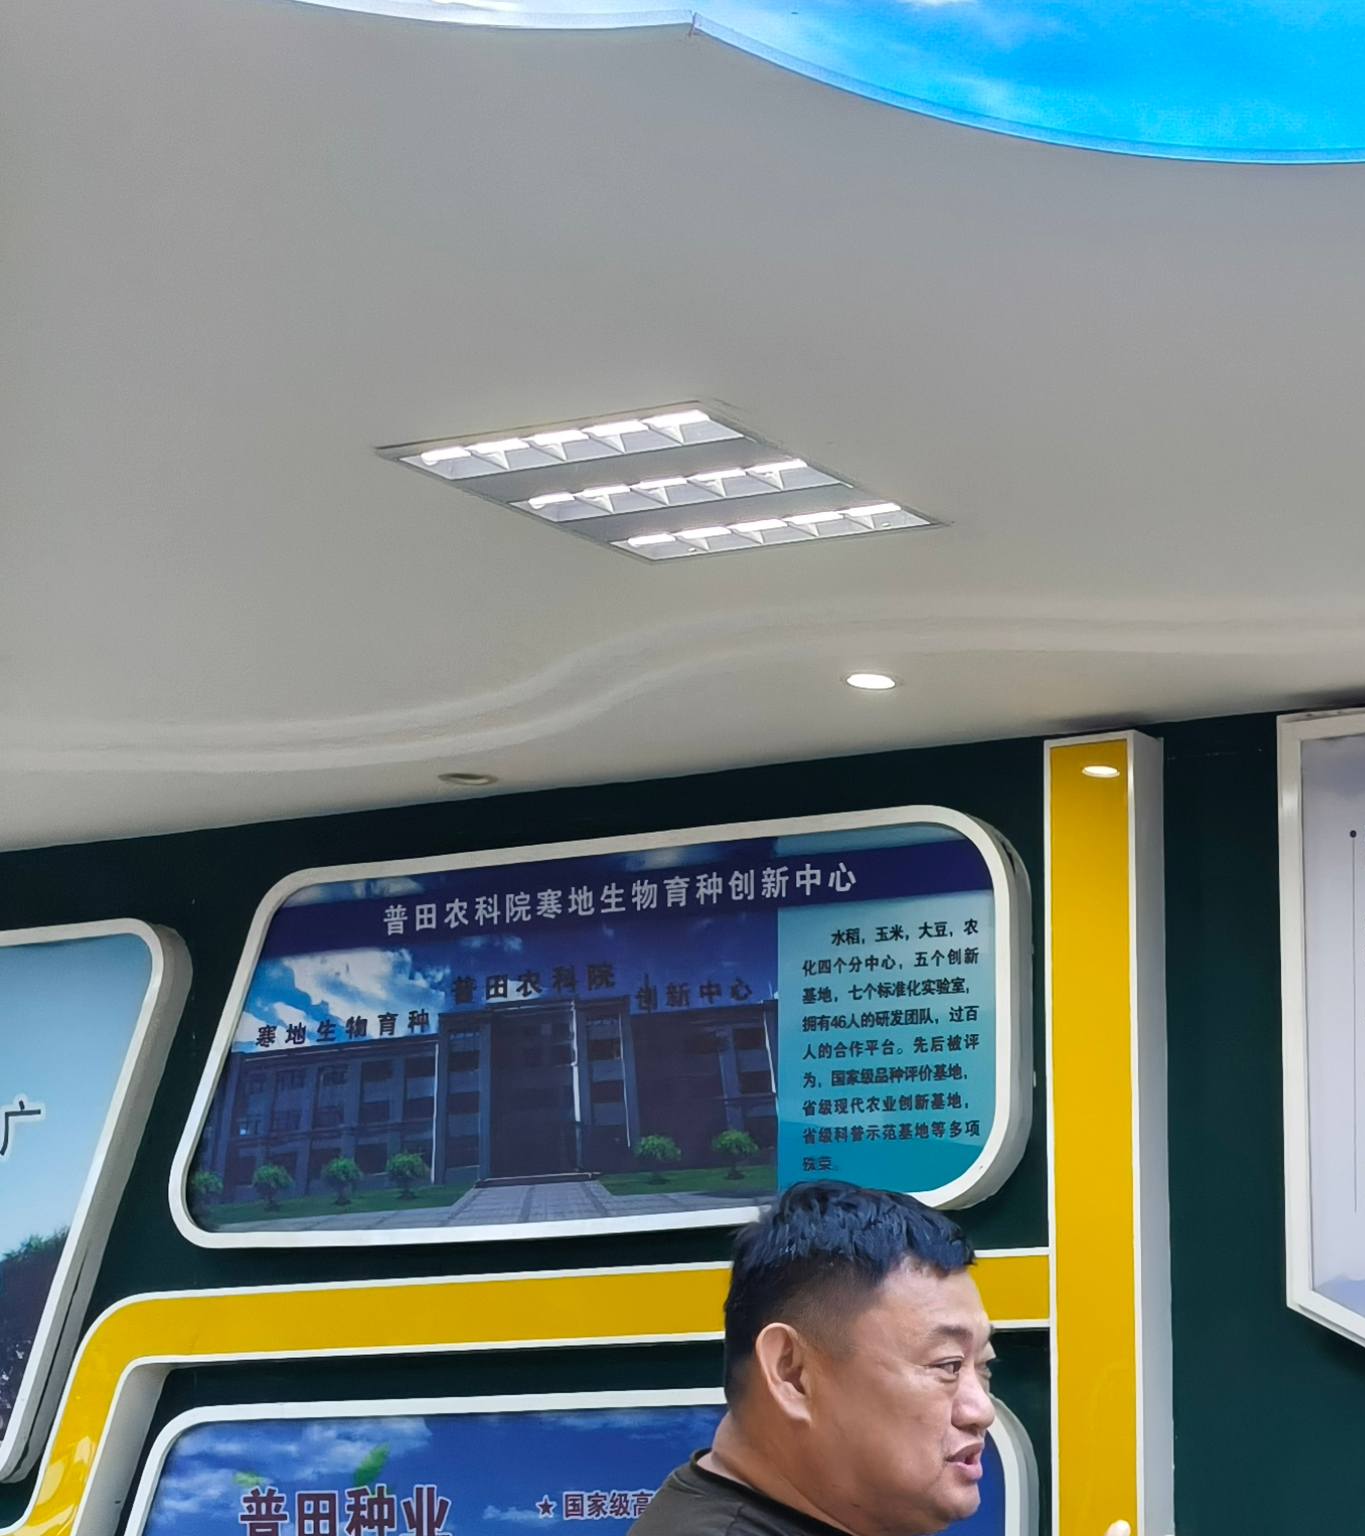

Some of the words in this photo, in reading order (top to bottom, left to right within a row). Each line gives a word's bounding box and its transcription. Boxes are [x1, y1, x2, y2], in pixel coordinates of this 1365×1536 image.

[383, 862, 857, 936] 普田农科院寒地生物育种创新中心
